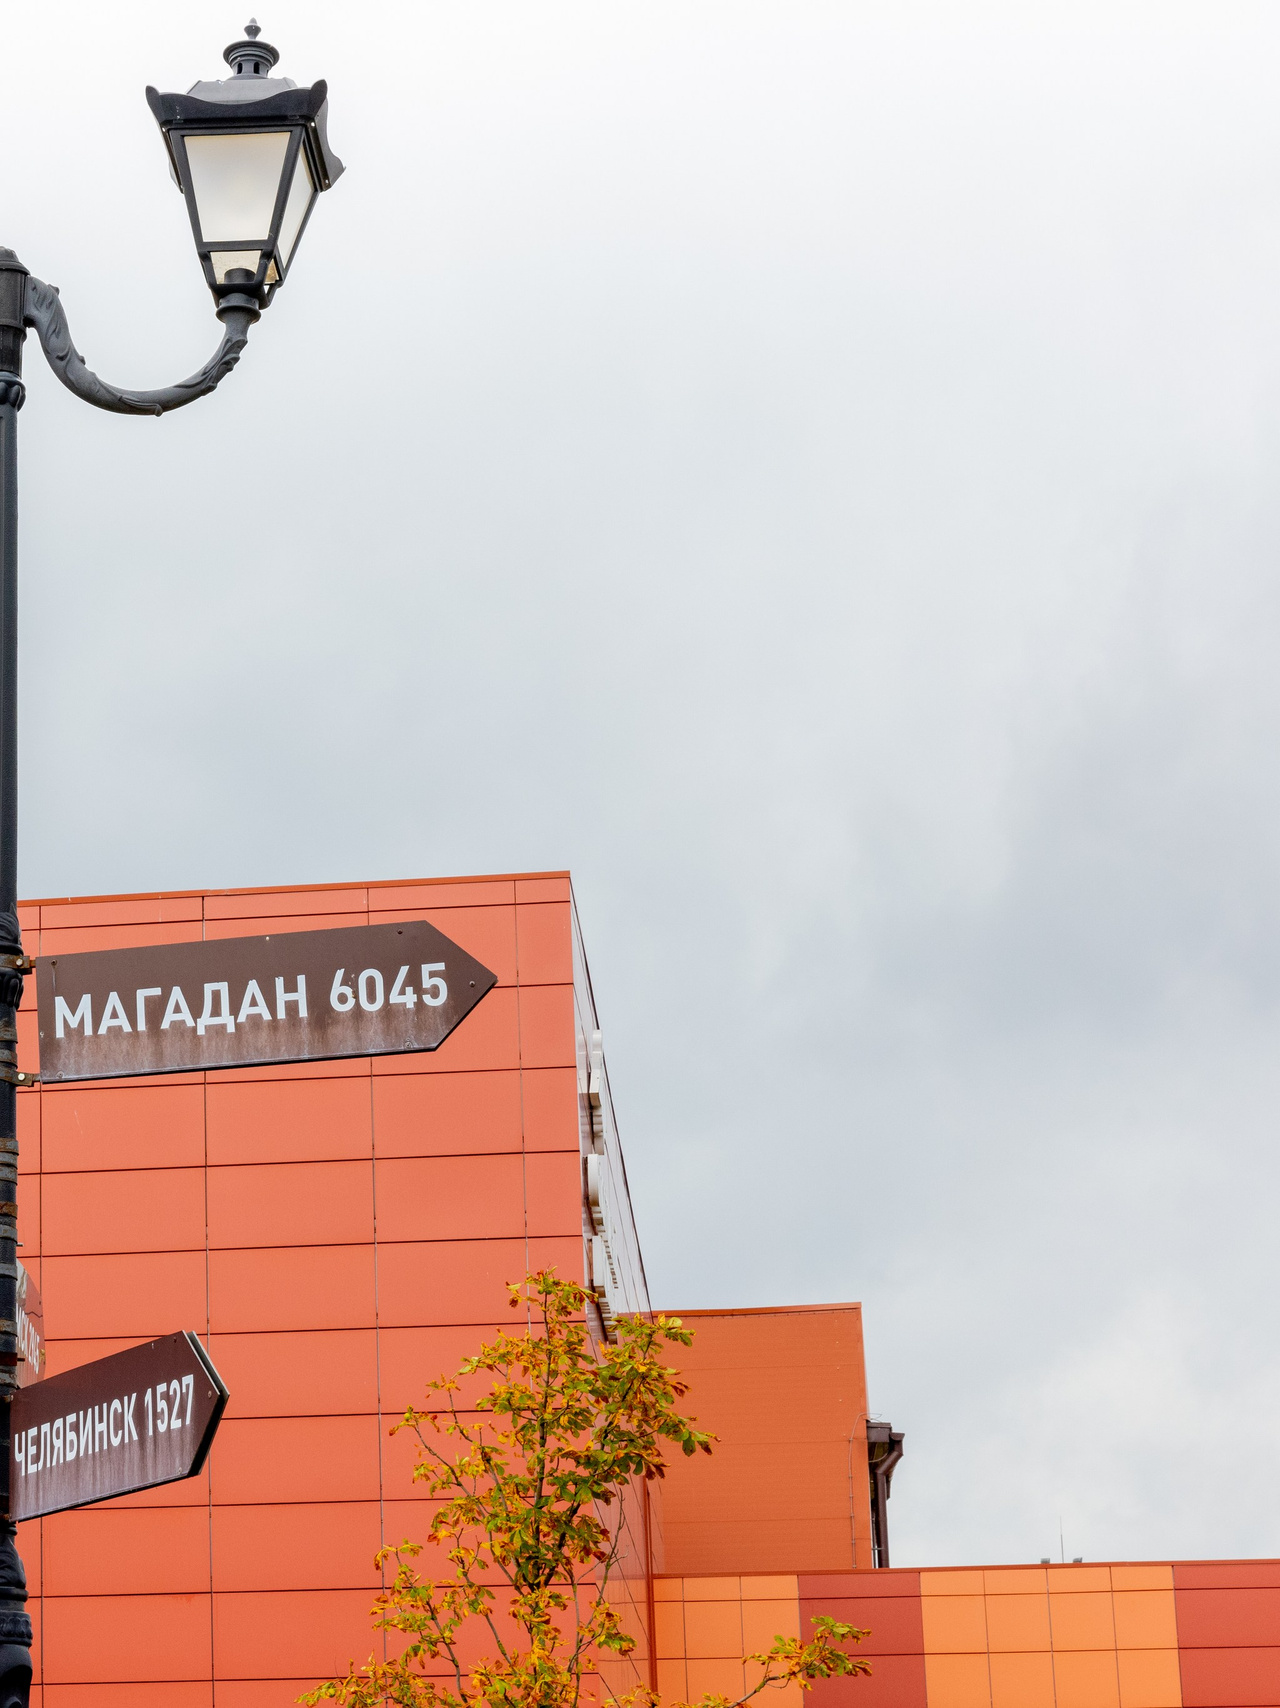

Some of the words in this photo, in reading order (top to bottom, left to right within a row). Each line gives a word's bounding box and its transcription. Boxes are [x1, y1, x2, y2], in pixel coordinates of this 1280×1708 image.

[54, 974, 309, 1039] МАГАДАН
[329, 962, 448, 1014] 6045
[14, 1392, 139, 1477] ЧЕЛЯБИНСК
[144, 1374, 194, 1436] 1527
